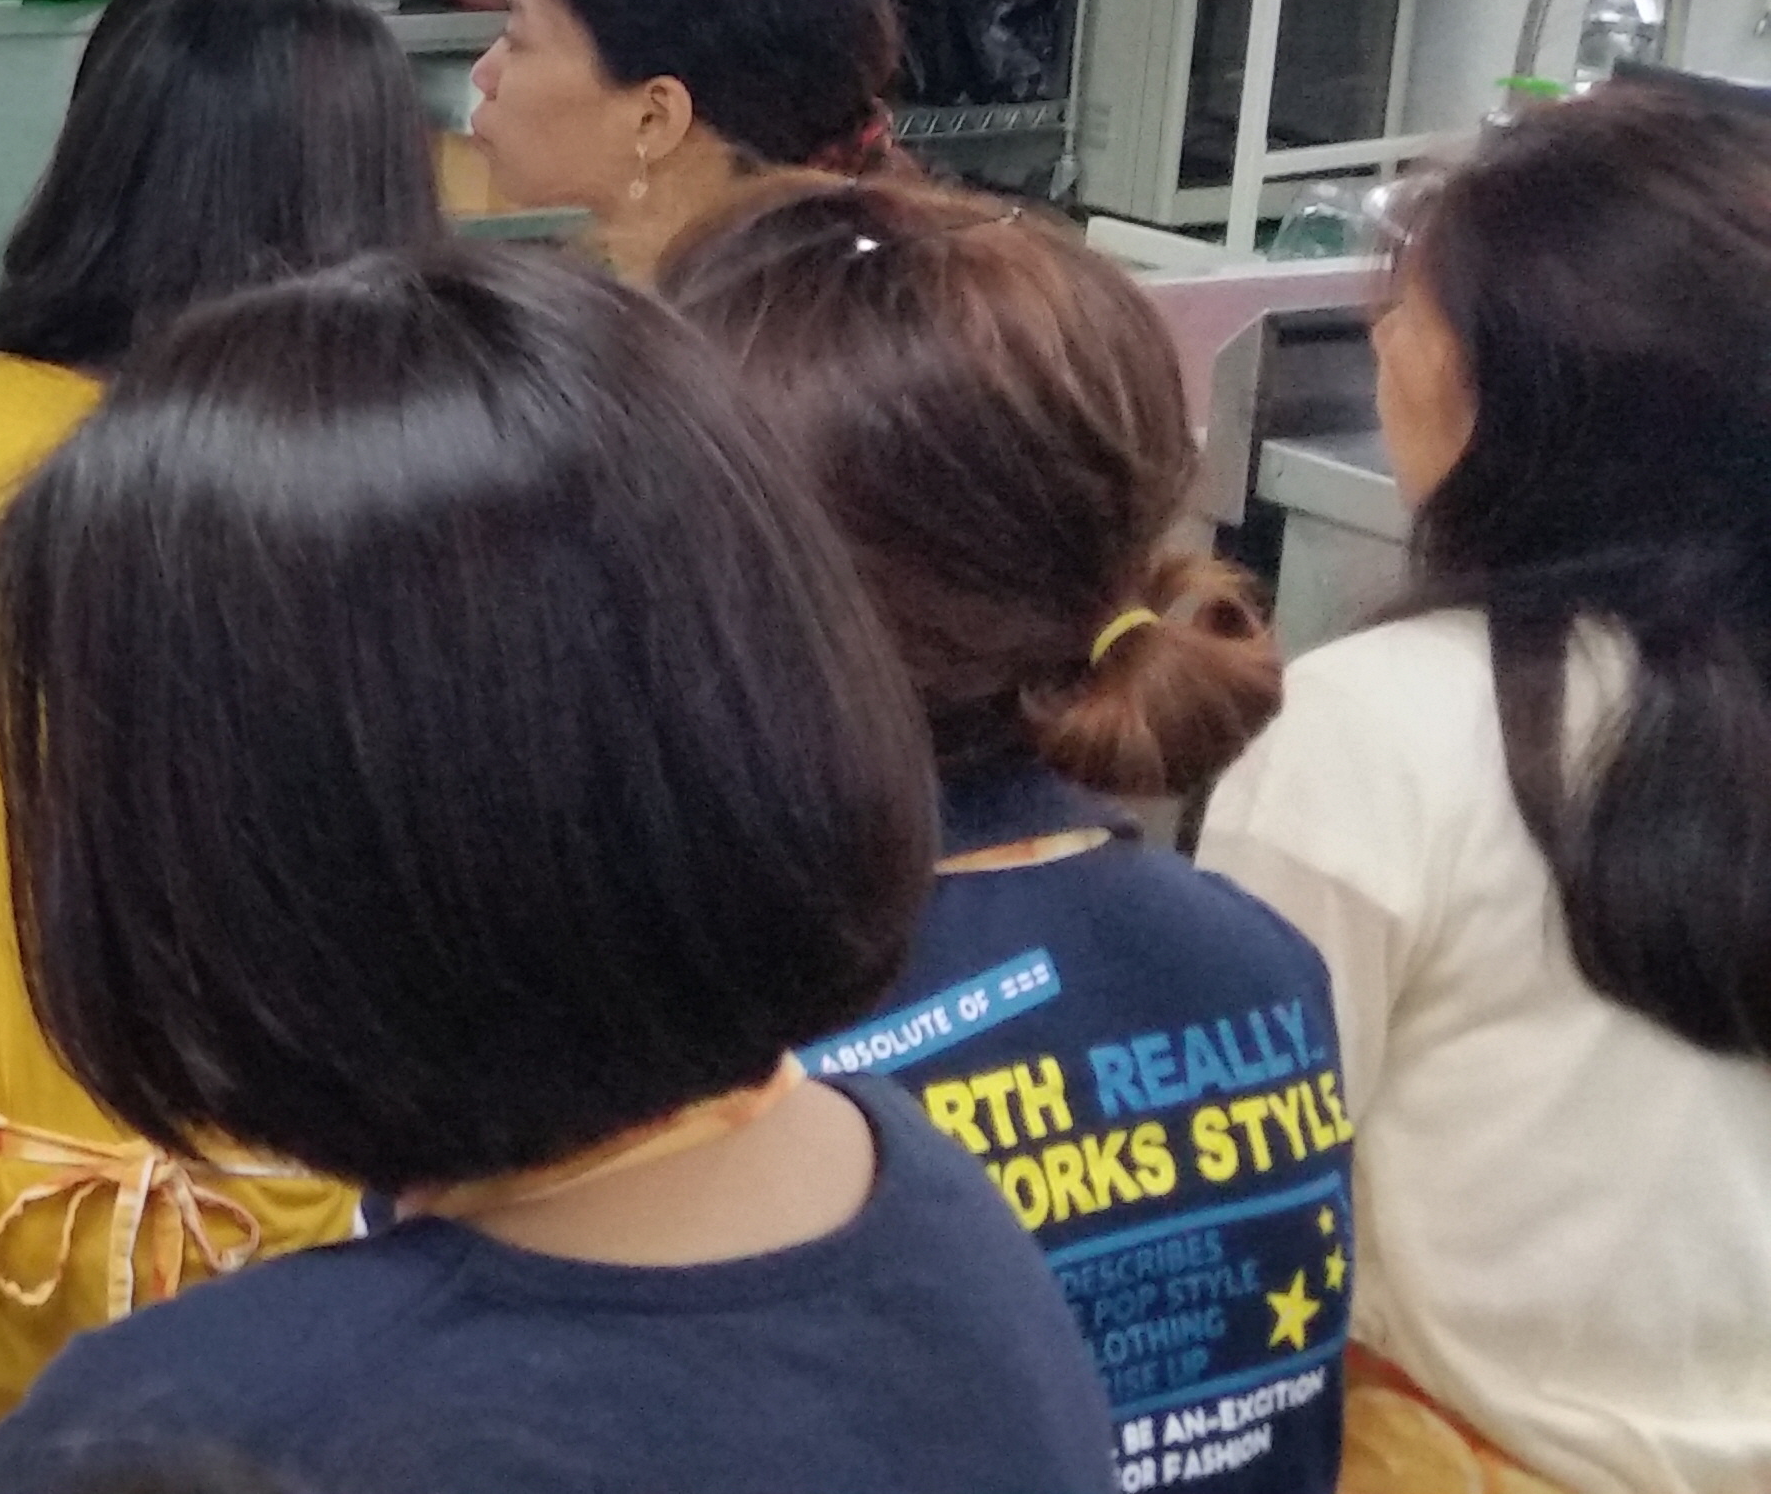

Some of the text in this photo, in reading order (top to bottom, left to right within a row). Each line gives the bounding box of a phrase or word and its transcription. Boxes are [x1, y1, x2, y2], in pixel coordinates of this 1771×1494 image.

[820, 1005, 953, 1074] ABSOLUTE
[958, 988, 990, 1022] OF
[985, 1070, 1356, 1233] ORKS STYLE
[1166, 1257, 1260, 1310] STYLE
[1084, 1305, 1227, 1366] OTHING
[1121, 1416, 1155, 1456] BE
[1161, 1422, 1272, 1484] FASHION
